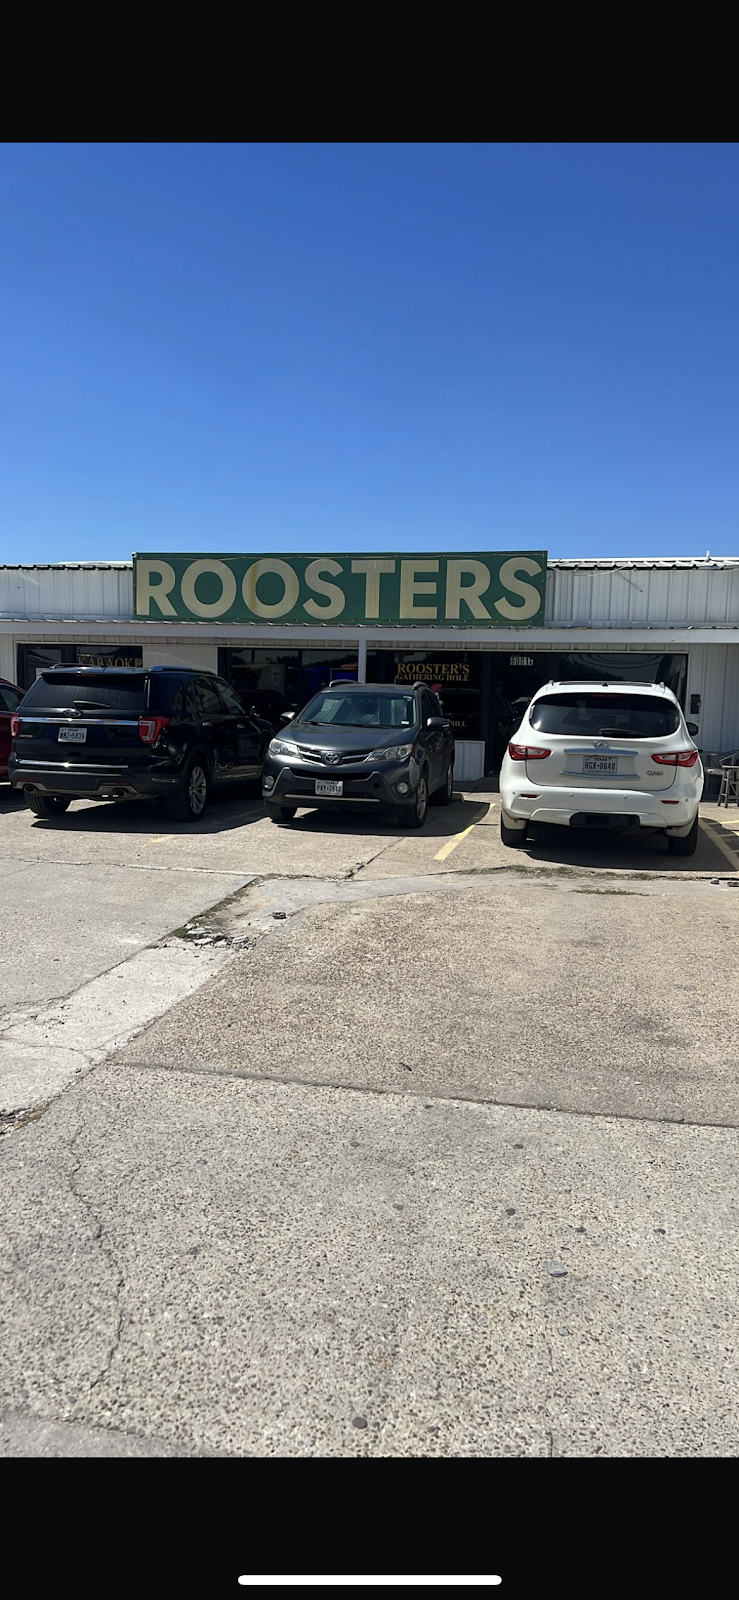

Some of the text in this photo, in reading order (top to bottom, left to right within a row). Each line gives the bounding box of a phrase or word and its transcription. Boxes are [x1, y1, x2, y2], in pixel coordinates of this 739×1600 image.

[136, 557, 543, 620] ROOSTERS
[78, 656, 143, 668] KARAOKE
[397, 663, 470, 675] ROOSTER'S
[396, 673, 470, 682] GATHERING HOLE
